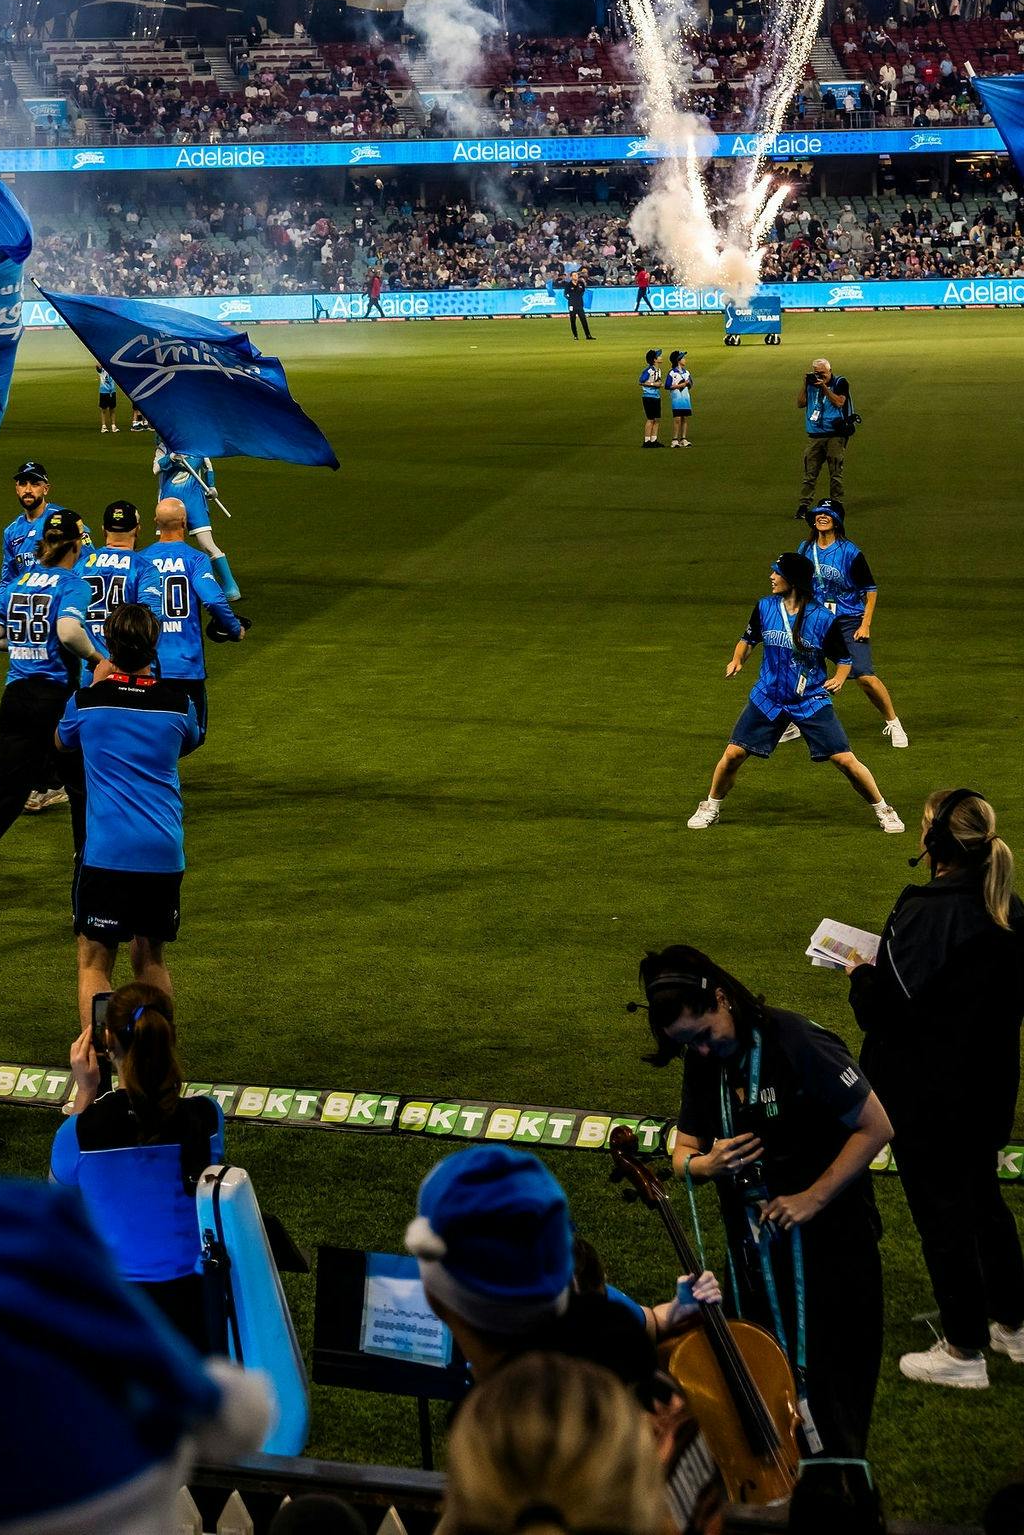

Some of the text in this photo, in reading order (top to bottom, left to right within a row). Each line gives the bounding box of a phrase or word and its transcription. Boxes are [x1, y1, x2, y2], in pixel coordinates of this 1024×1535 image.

[176, 146, 265, 166] Adelaide
[453, 141, 541, 161] Adelaide
[732, 134, 821, 154] Adelaide
[96, 553, 131, 570] RAA
[7, 592, 53, 644] 58
[81, 576, 127, 622] 24
[238, 1092, 320, 1115] BKT
[322, 1097, 400, 1121] BKT
[401, 1106, 483, 1131] BKT
[488, 1113, 574, 1139] BKT
[577, 1122, 661, 1147] BT
